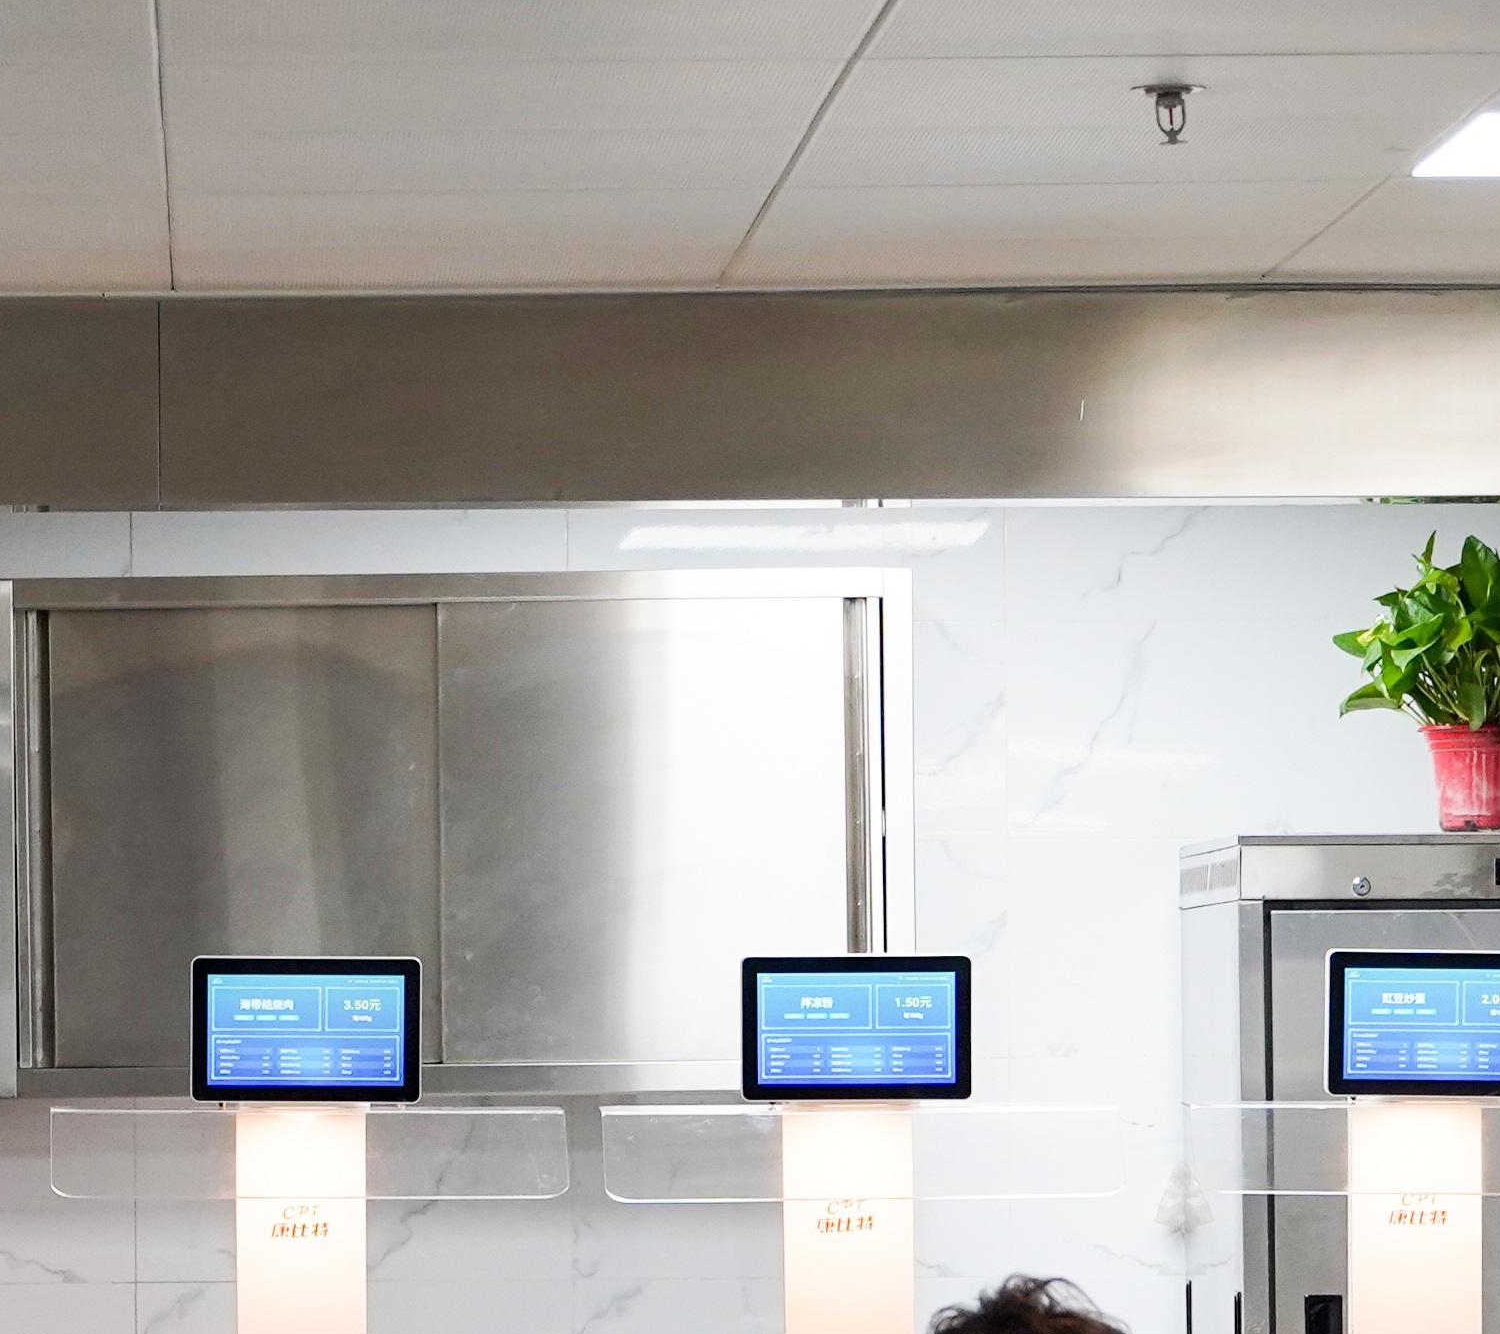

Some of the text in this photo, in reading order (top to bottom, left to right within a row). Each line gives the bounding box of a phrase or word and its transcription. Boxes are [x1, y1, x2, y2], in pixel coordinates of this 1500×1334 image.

[343, 999, 382, 1011] 3.50元
[894, 996, 933, 1009] 1.50元
[271, 1222, 330, 1238] 康比特
[817, 1215, 873, 1233] 康比特
